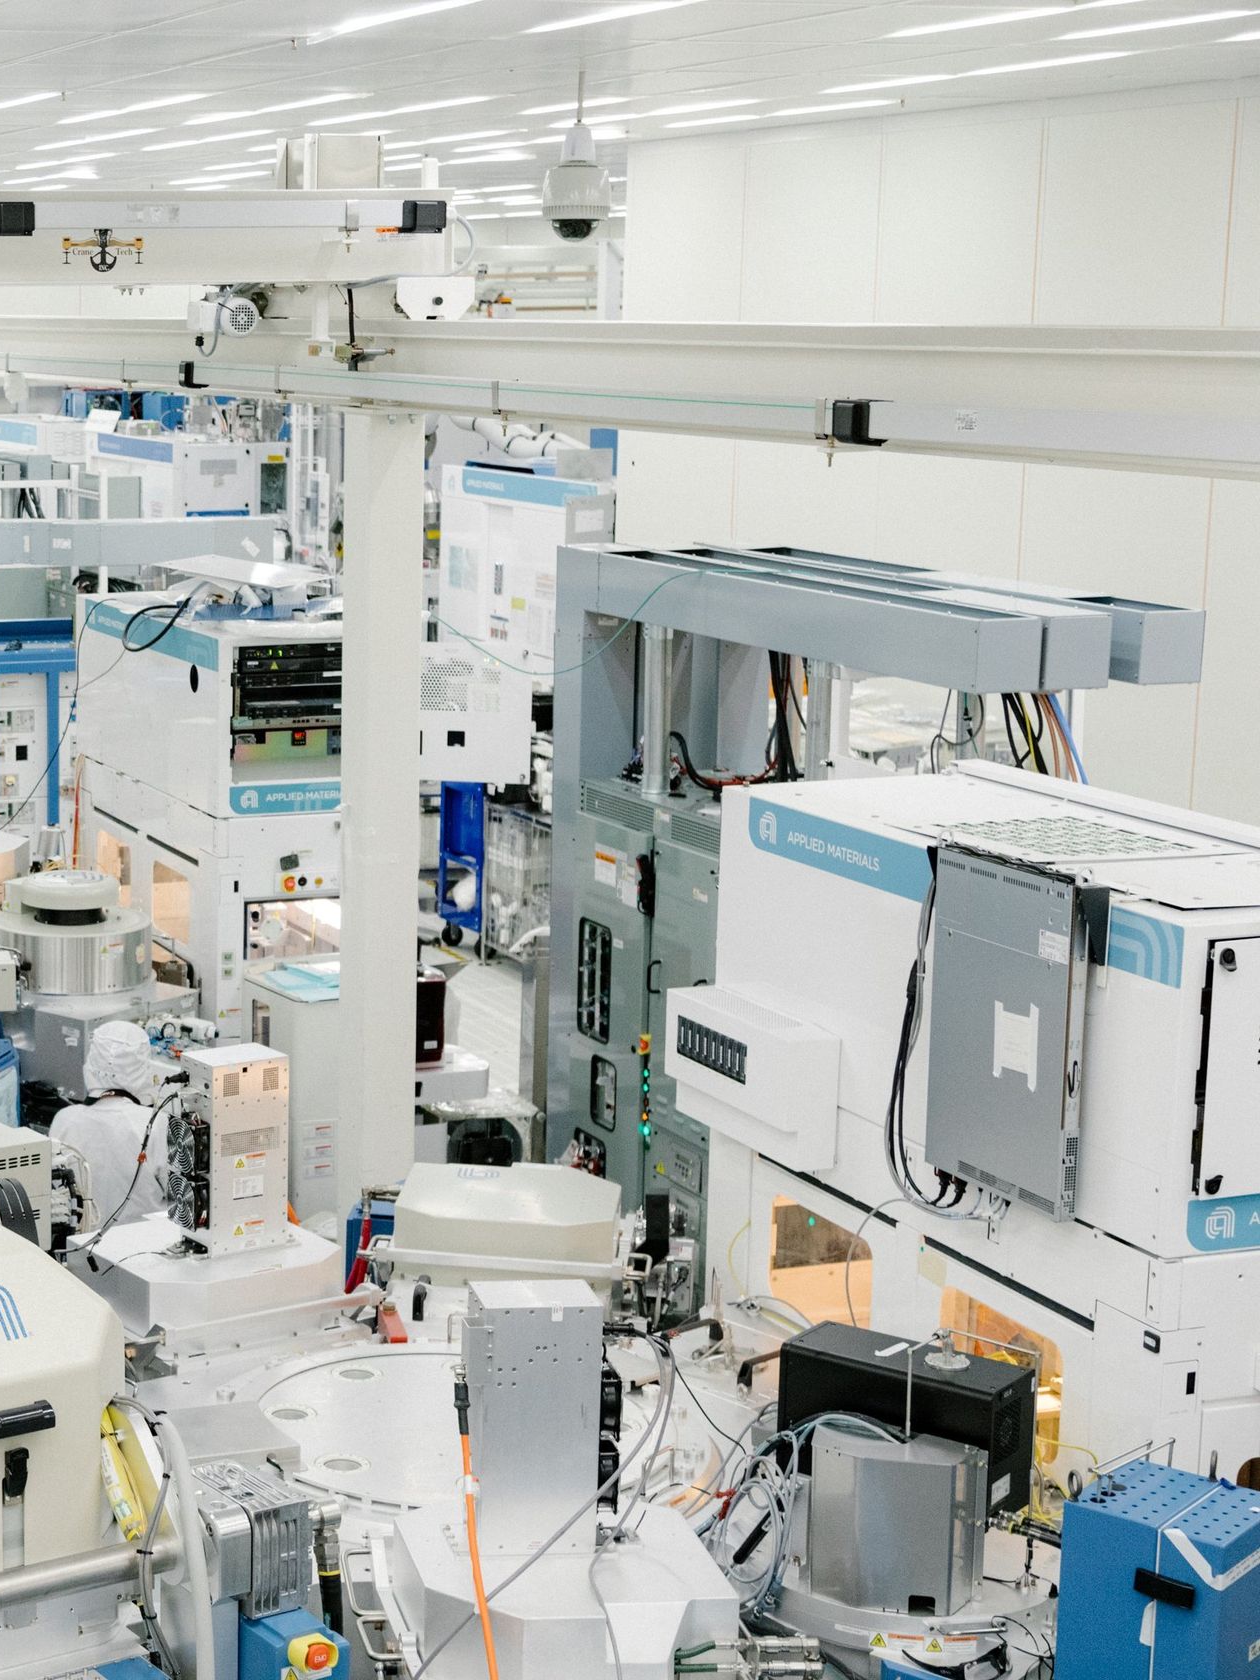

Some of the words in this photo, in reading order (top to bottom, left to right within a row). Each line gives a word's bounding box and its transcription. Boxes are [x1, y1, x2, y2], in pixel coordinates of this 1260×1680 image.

[72, 248, 93, 256] Crane
[116, 247, 133, 256] Tech
[266, 791, 304, 802] APPLIED
[787, 831, 826, 854] APPLIED
[827, 842, 880, 872] MATERIALS
